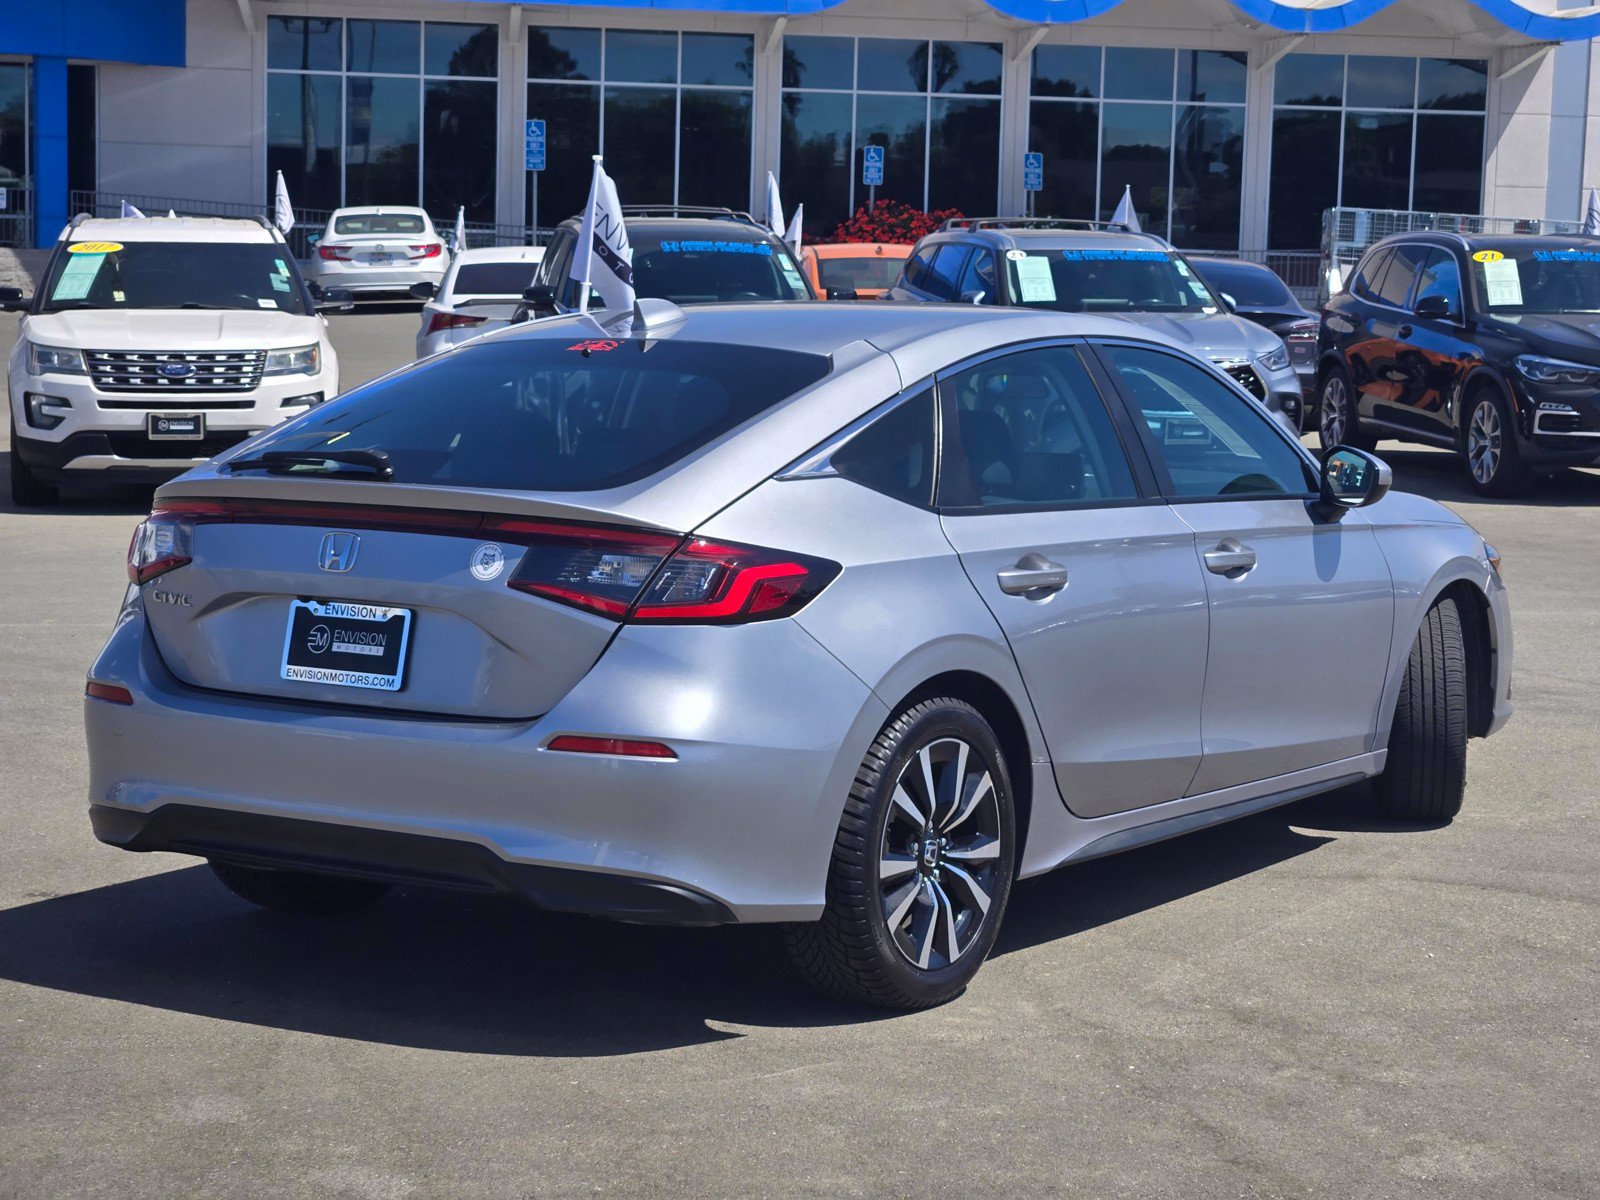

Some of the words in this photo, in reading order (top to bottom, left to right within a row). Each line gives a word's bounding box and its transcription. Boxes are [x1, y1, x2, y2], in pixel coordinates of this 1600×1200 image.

[152, 590, 193, 607] CIVIC
[324, 604, 377, 619] ENVISION
[333, 629, 388, 646] ENVISION
[336, 644, 381, 654] MOTORS
[286, 668, 395, 688] ENVISIONMOTORS.COM
